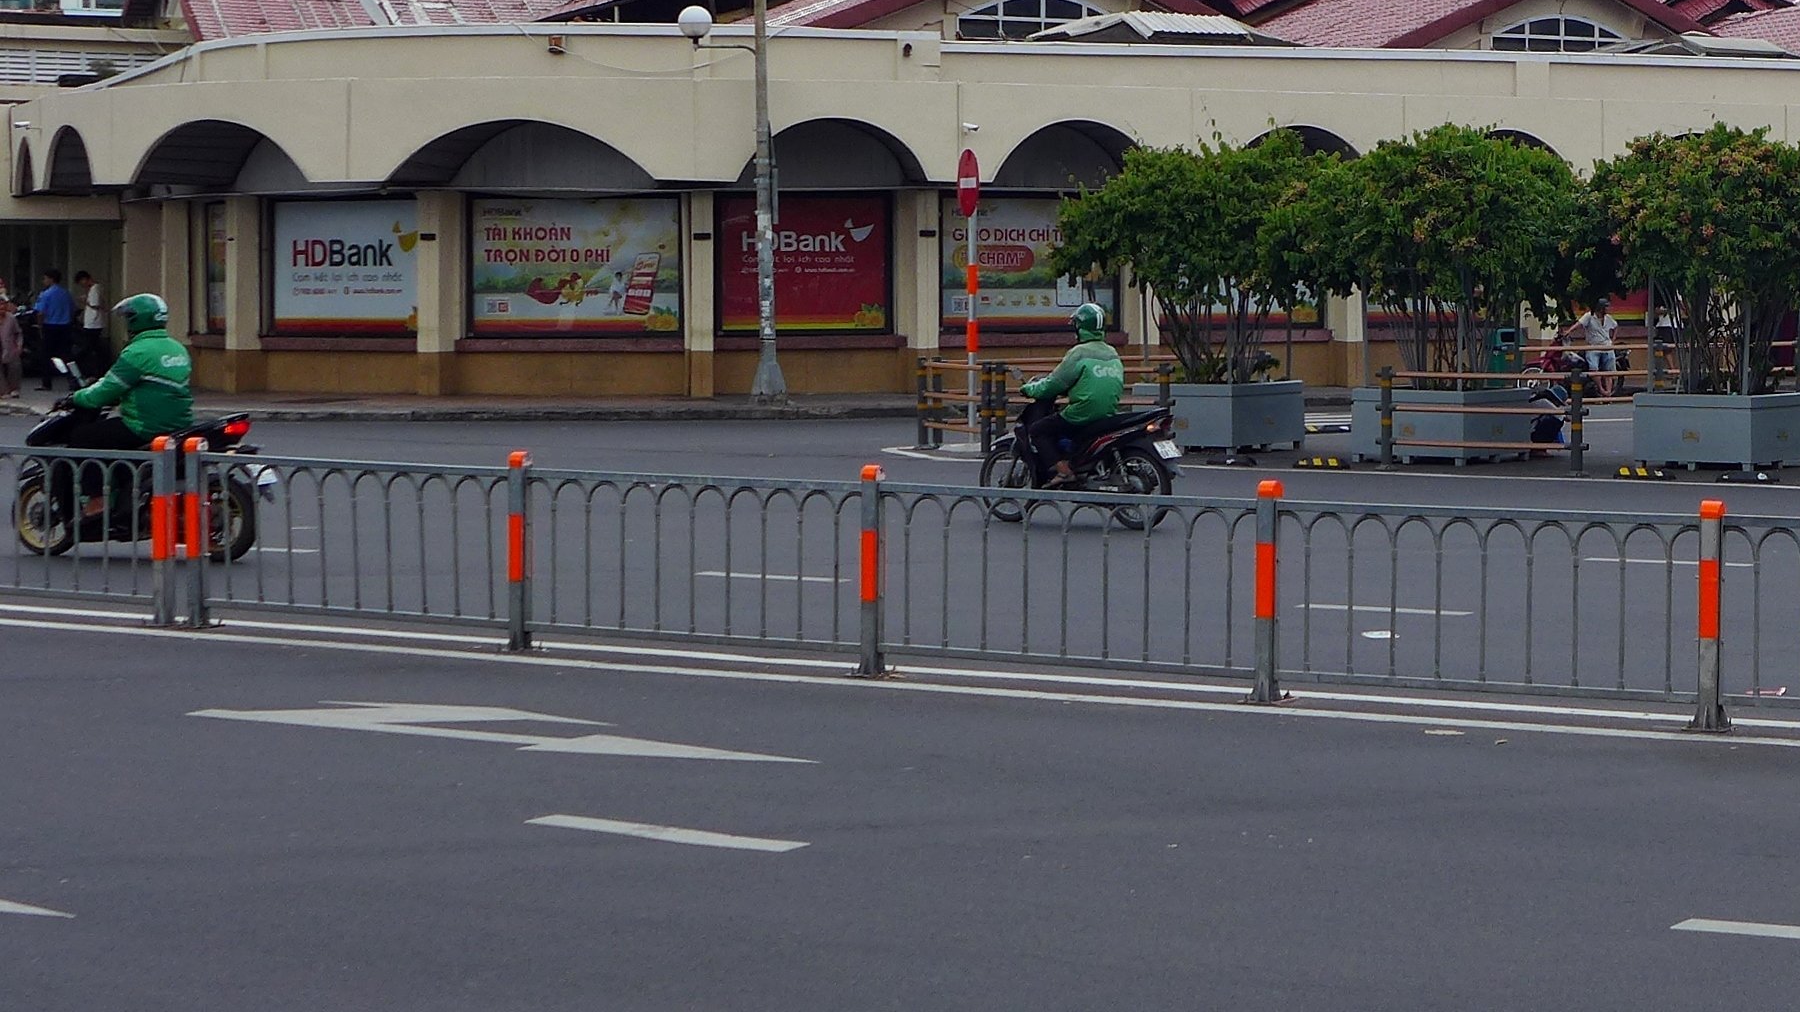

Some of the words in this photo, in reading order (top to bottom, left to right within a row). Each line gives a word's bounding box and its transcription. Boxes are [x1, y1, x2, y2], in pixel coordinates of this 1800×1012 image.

[484, 223, 507, 241] TÀI
[952, 228, 991, 242] GIO
[292, 238, 394, 267] HDBank
[484, 249, 530, 266] TRỌN
[584, 245, 612, 263] PHÍ
